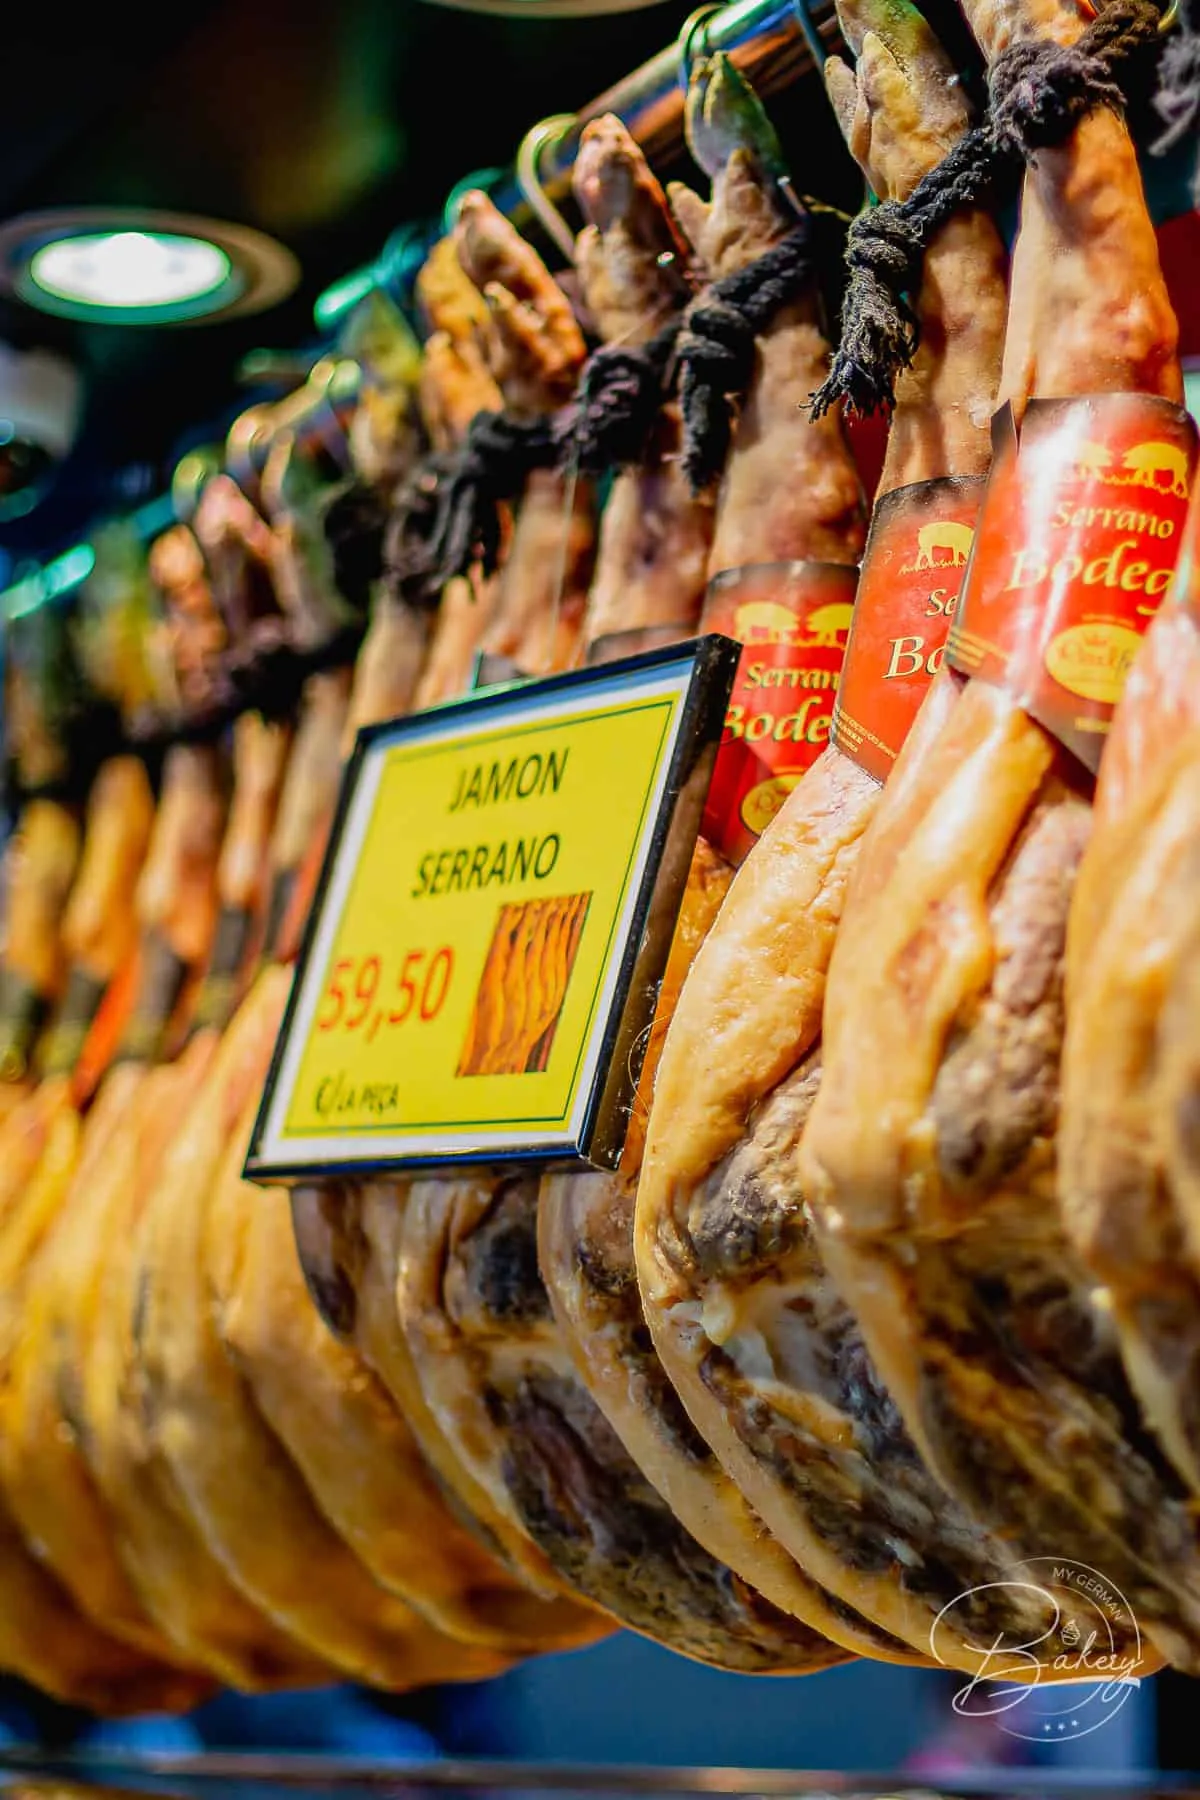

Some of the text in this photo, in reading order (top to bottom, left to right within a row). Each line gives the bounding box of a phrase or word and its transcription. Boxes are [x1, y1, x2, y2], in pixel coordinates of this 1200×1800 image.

[1051, 500, 1175, 540] Serrano
[448, 747, 569, 814] JAMON
[411, 832, 561, 898] SERRANO
[317, 944, 454, 1044] 59,50
